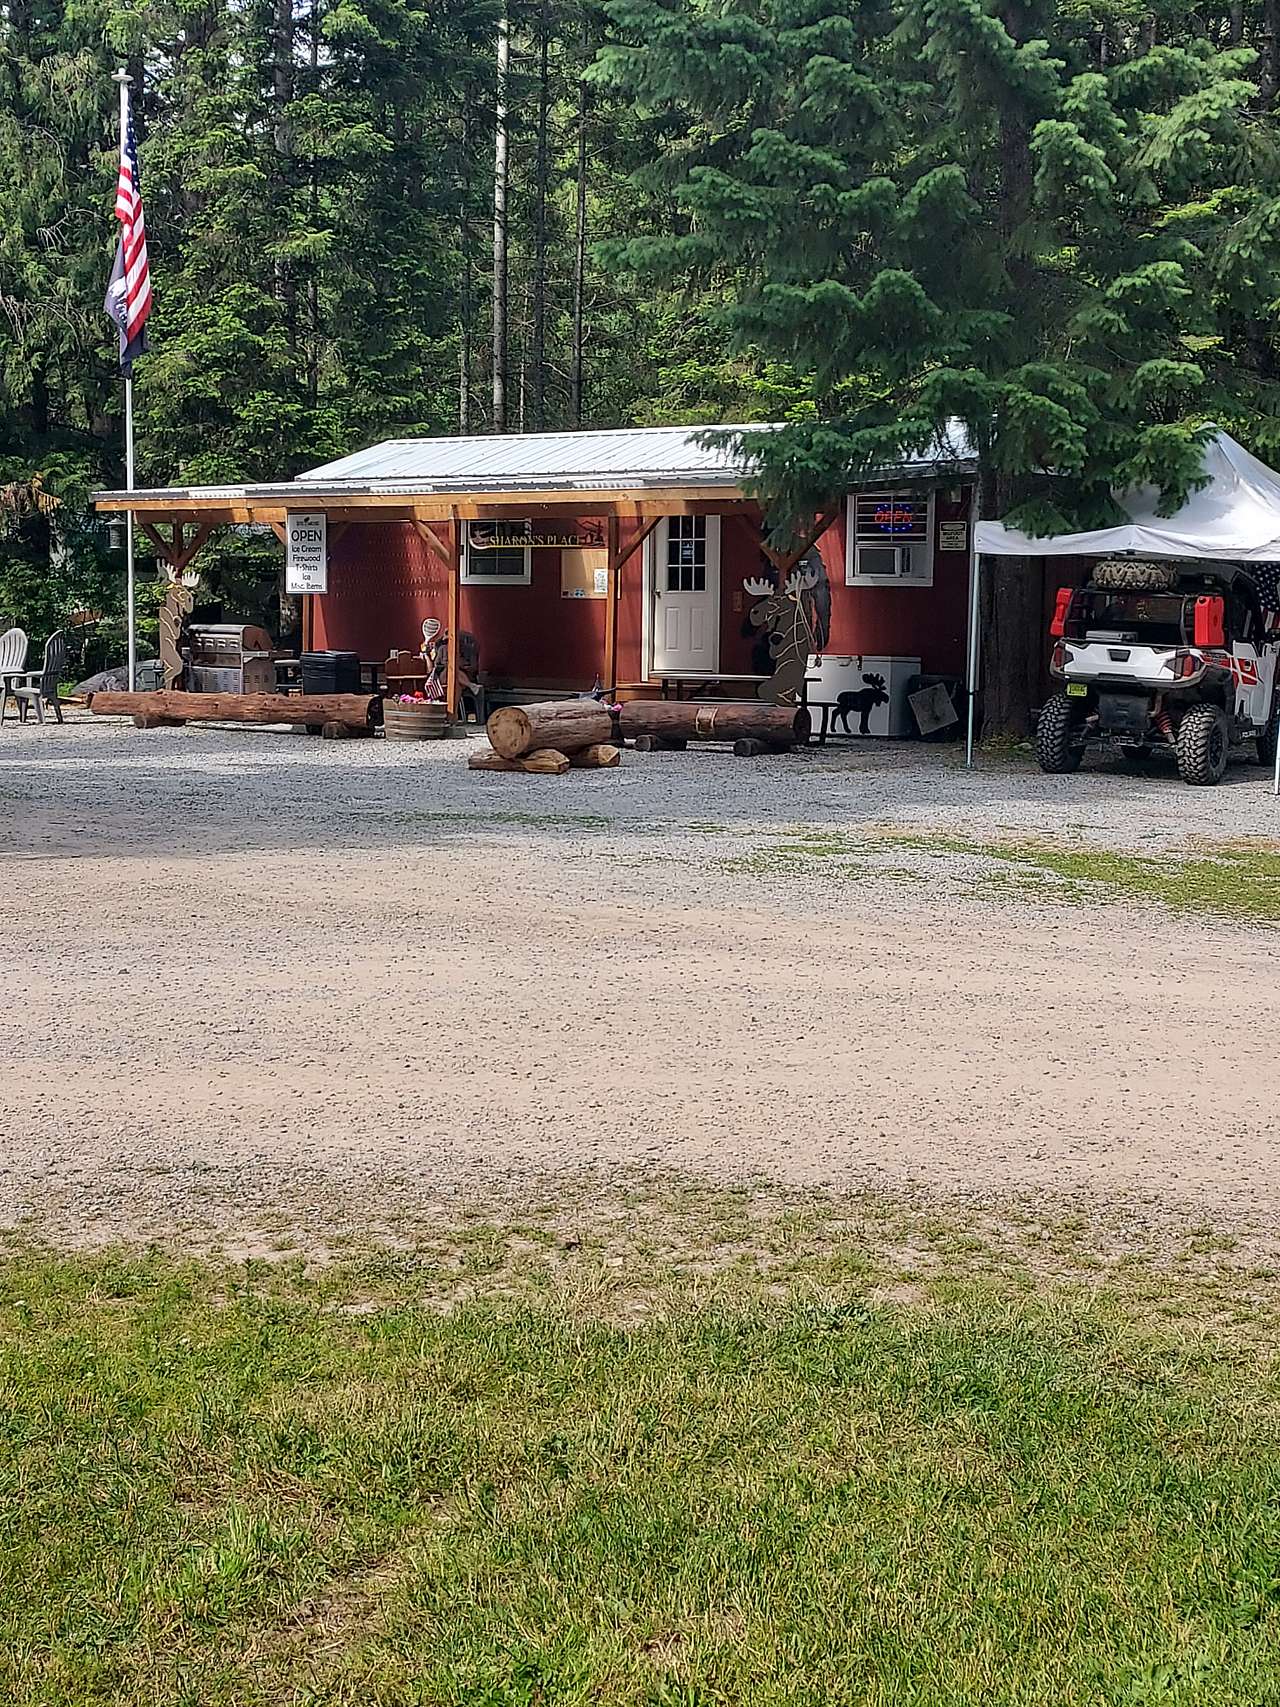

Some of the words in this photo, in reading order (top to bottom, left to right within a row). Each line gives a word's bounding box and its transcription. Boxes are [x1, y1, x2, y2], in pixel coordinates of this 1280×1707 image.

[291, 530, 322, 542] OPEN
[490, 534, 544, 545] SHARON'S
[291, 545, 300, 553] Ice
[301, 545, 322, 553] Cream
[292, 554, 321, 562] Firewood
[296, 563, 318, 571] T-Shirts
[302, 573, 311, 581] Ice
